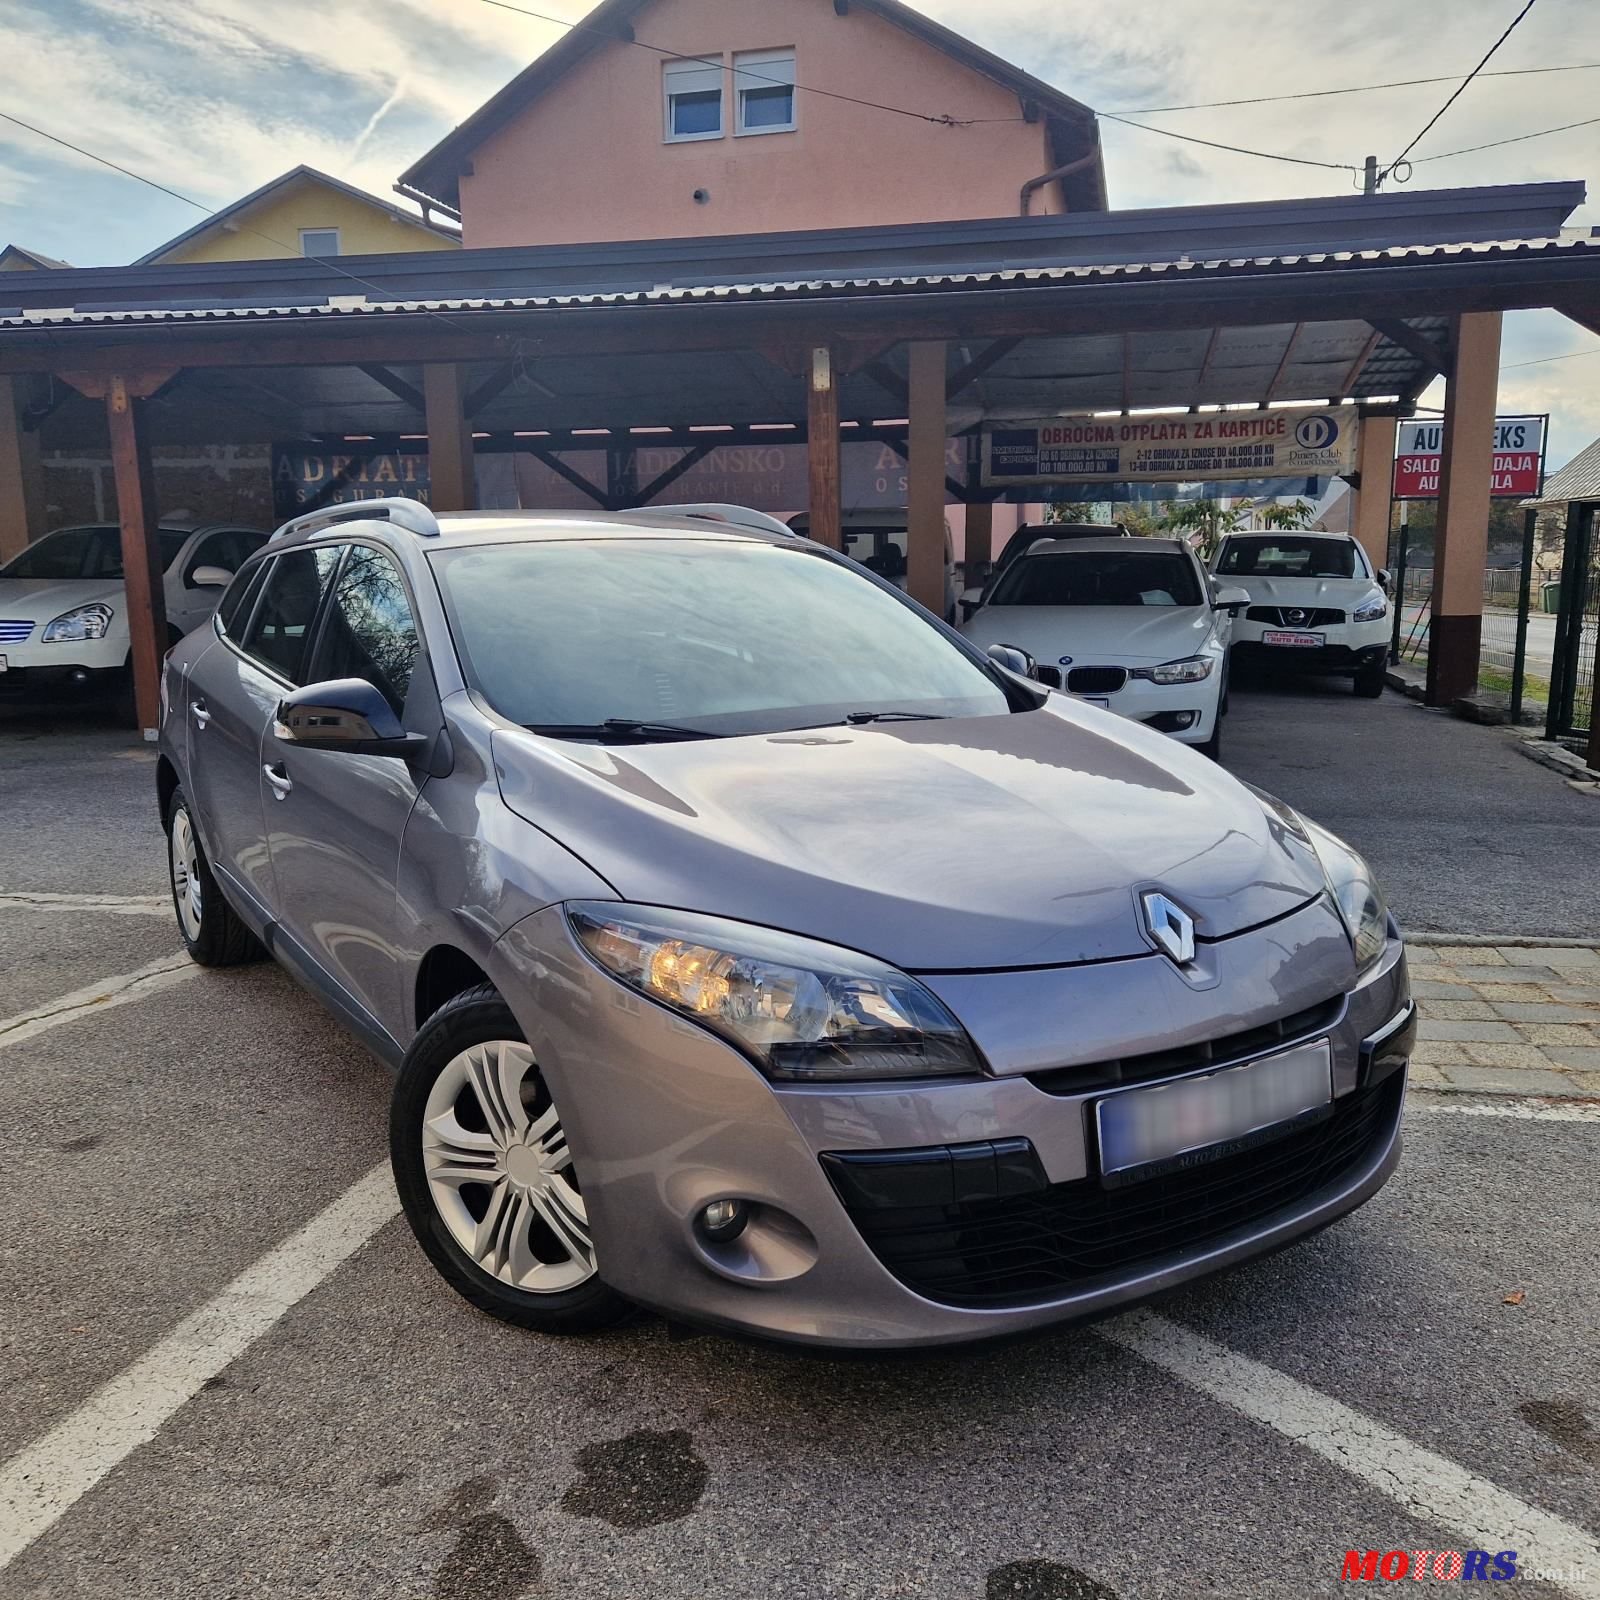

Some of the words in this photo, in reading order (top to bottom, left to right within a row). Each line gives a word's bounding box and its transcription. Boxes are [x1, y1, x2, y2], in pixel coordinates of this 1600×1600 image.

[1120, 423, 1187, 441] OTPLATA
[1194, 421, 1212, 438] ZA
[1218, 418, 1285, 437] KARTICE
[1413, 427, 1443, 450] AU
[1086, 449, 1094, 460] ZA
[1095, 448, 1118, 460] IZNOSE
[1137, 449, 1152, 460] 2-12
[1153, 447, 1180, 460] OBROKA
[1181, 447, 1190, 459] ZA
[1191, 446, 1215, 458] IZNOSE
[1217, 446, 1226, 458] DO
[1264, 444, 1275, 455] KN
[1289, 450, 1319, 461] Diners
[1320, 448, 1342, 459] Club
[612, 448, 786, 480] JADRNSKO
[1149, 459, 1175, 472] OBROKA
[1176, 459, 1186, 471] ZA
[1187, 458, 1211, 471] IZNOSE
[1213, 458, 1222, 470] DO
[1264, 455, 1274, 467] KN
